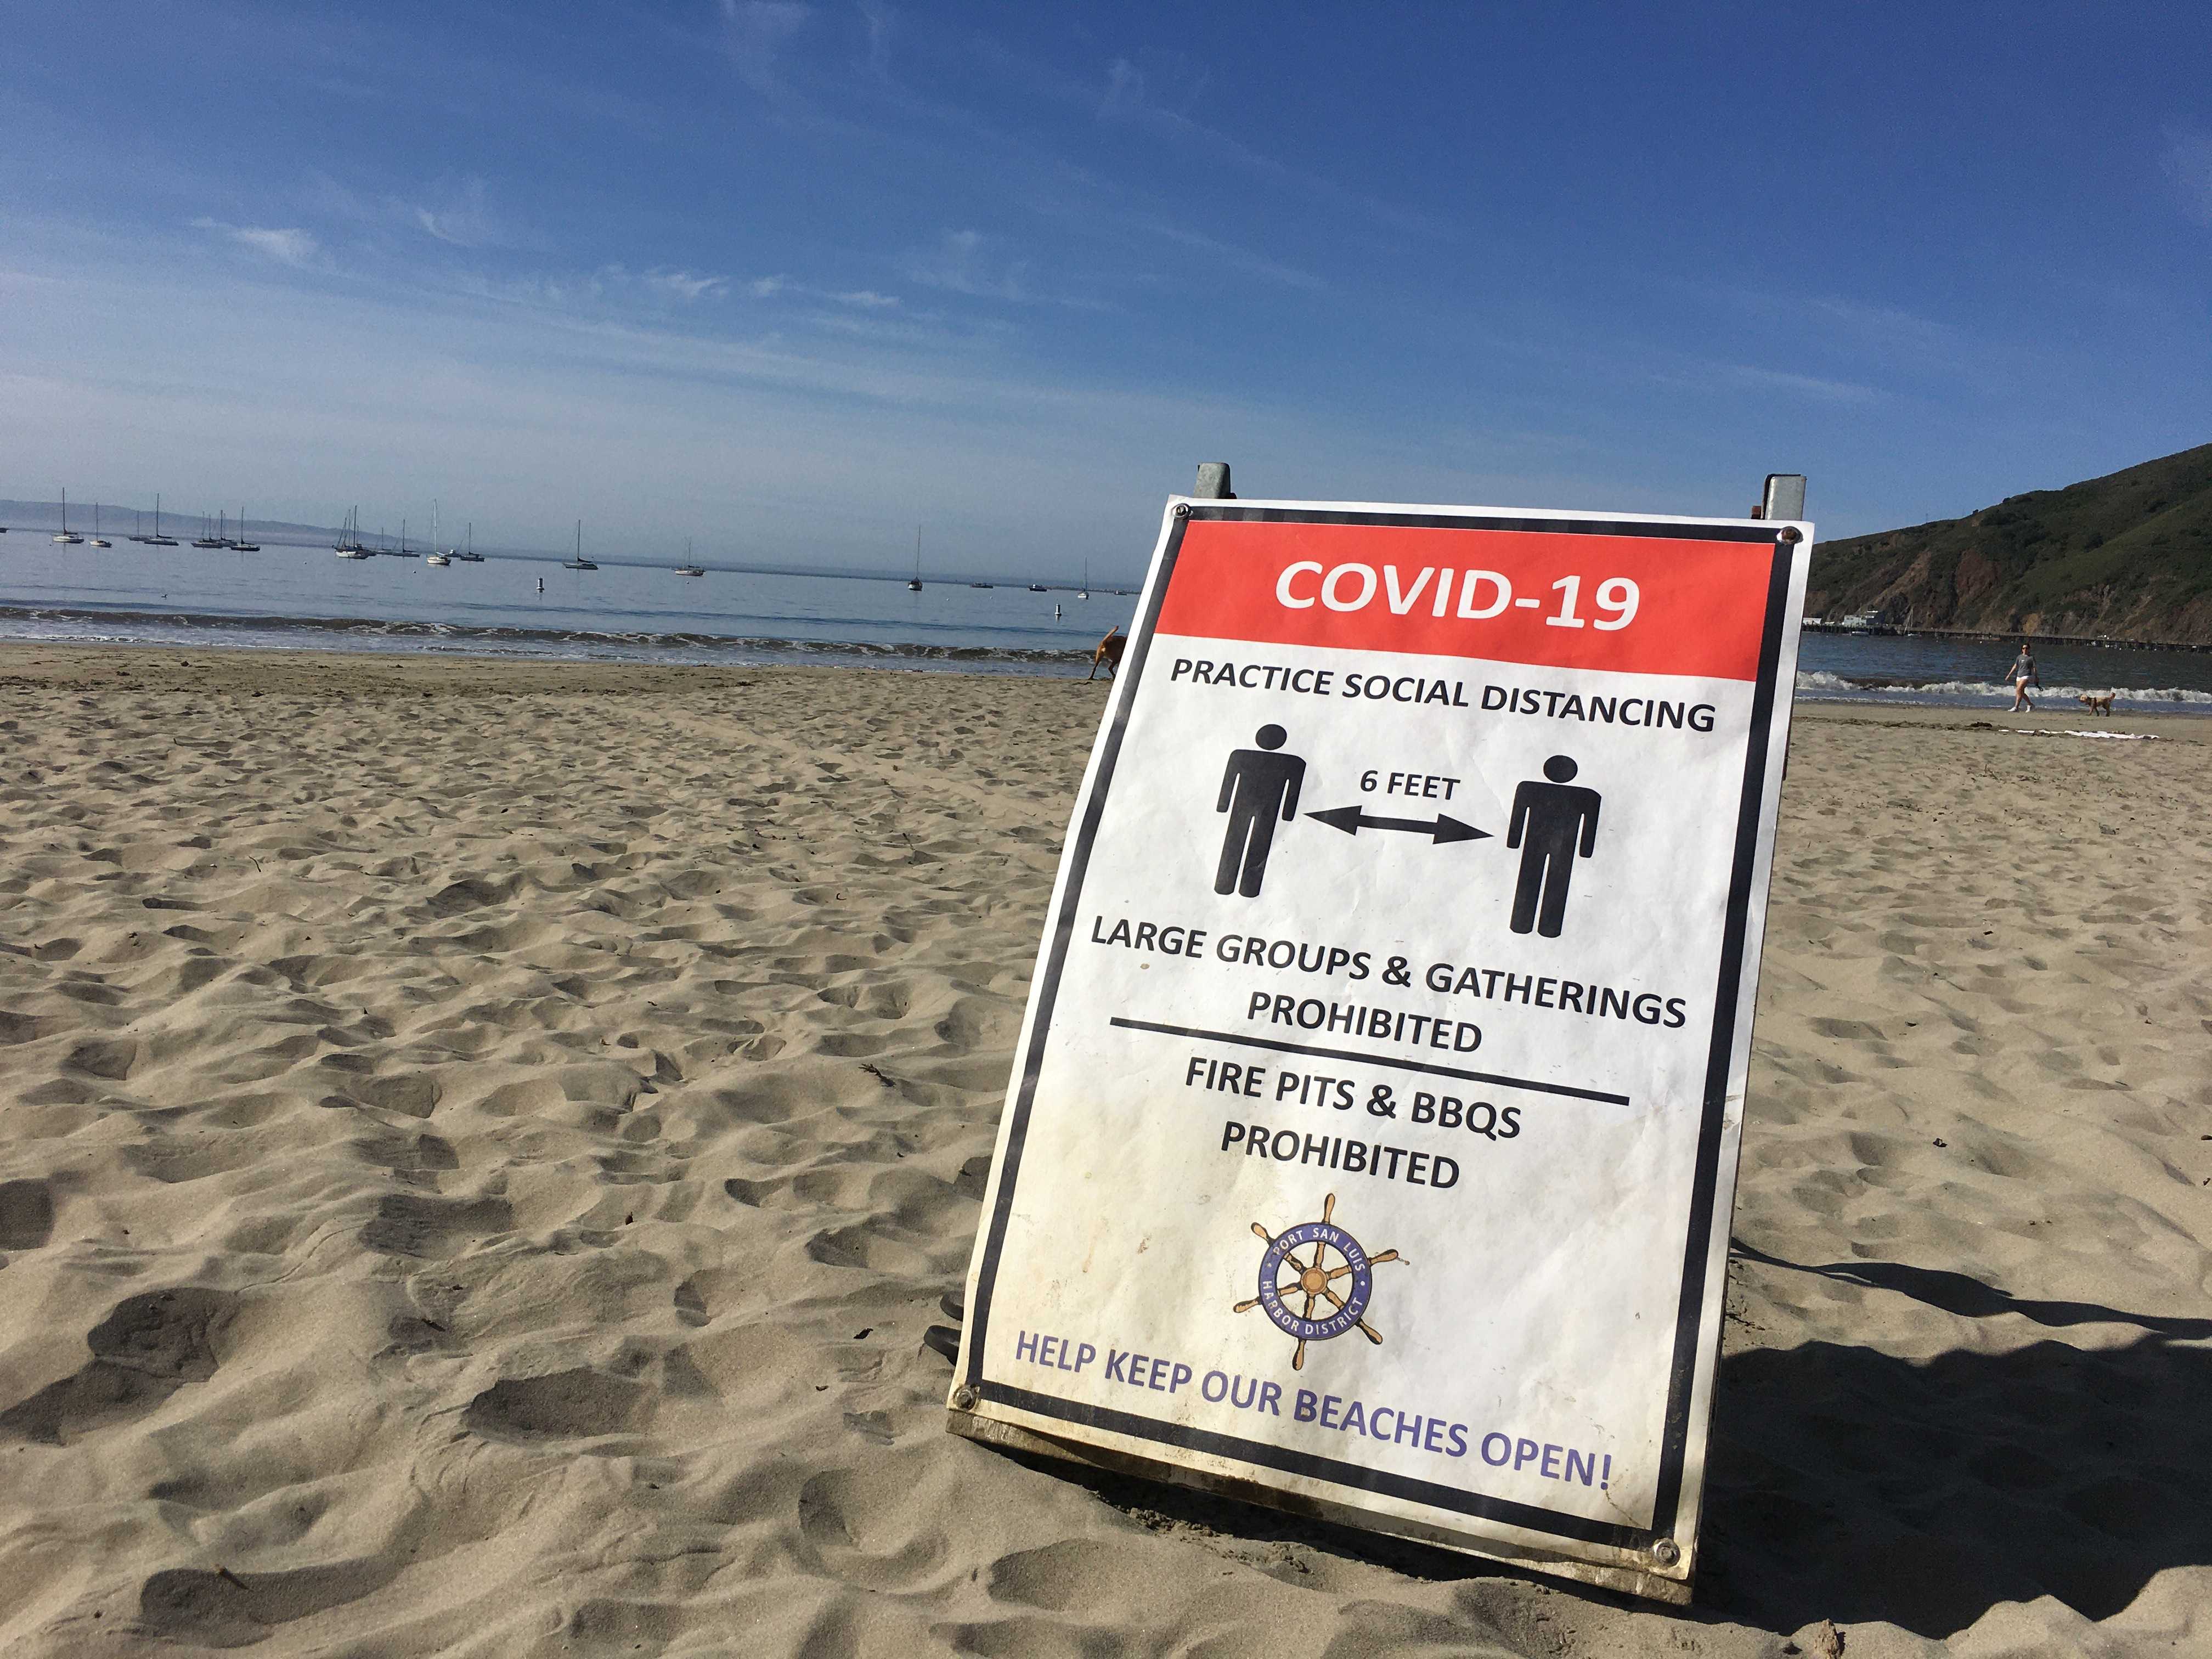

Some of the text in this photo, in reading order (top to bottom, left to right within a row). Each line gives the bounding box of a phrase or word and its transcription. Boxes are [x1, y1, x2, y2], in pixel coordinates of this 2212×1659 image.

[1274, 560, 1640, 631] COVID-19
[1170, 658, 1717, 733] PRACTICE SOCIAL DISTANCING
[1359, 769, 1462, 801] 6 FEET
[1091, 915, 1688, 1030] LARGE GROUPS & GATHERINGS
[1247, 991, 1483, 1053] PROHIBITED
[1185, 1056, 1522, 1142] FIRE PITS & BBQS
[1221, 1120, 1460, 1189] PROHIBITED
[1273, 1227, 1365, 1271] PORT SAN LUIS
[1262, 1281, 1363, 1335] HARBOR DISTRICT
[1015, 1330, 1612, 1491] HELP KEEP OUR BEACHES OPEN!
